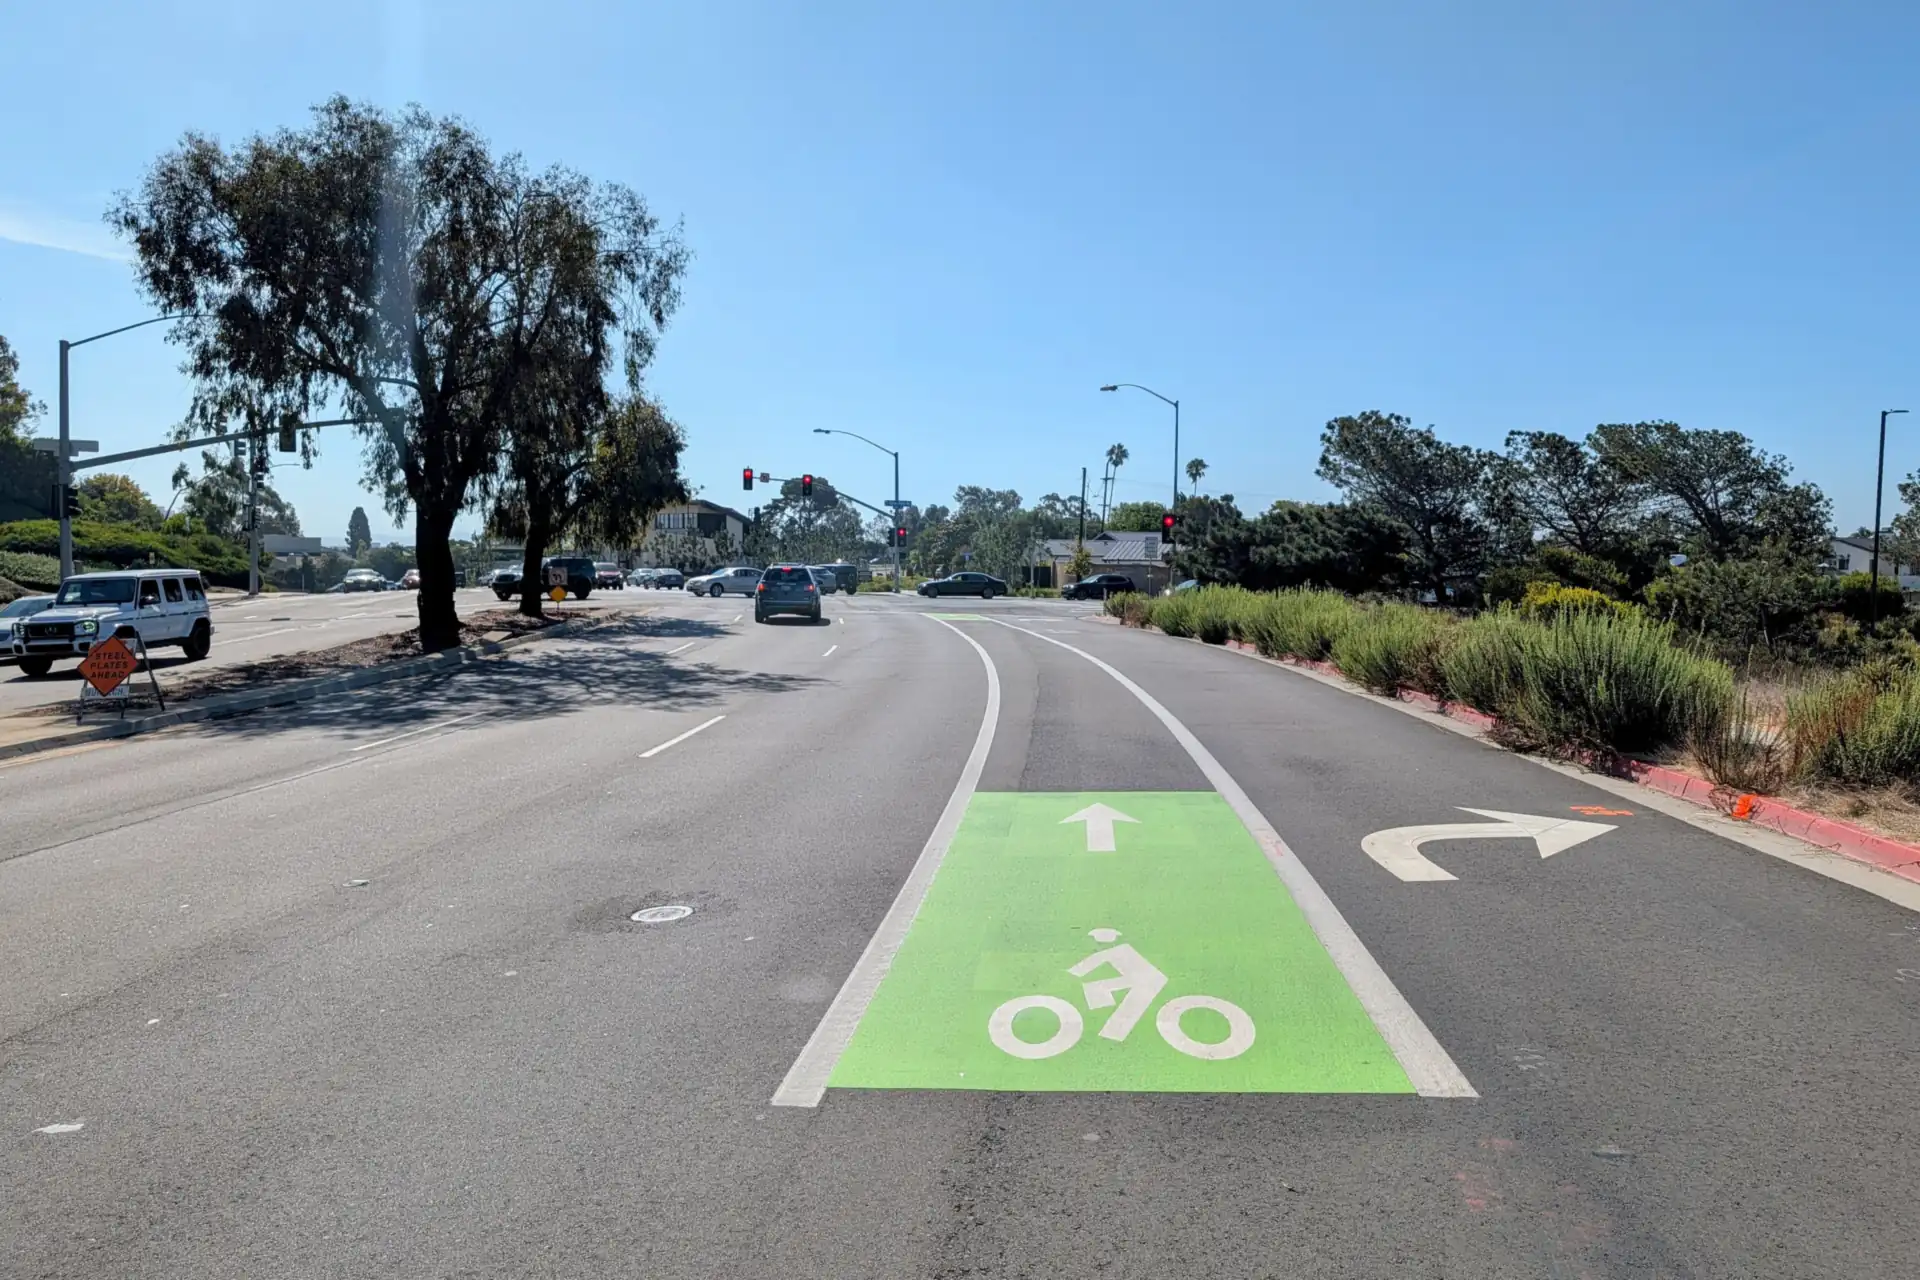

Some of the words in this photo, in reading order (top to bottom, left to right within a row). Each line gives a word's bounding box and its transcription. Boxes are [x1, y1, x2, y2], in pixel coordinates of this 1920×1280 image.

[96, 652, 126, 660] STEEL
[90, 661, 128, 670] PLATES
[90, 671, 124, 679] AHEAD
